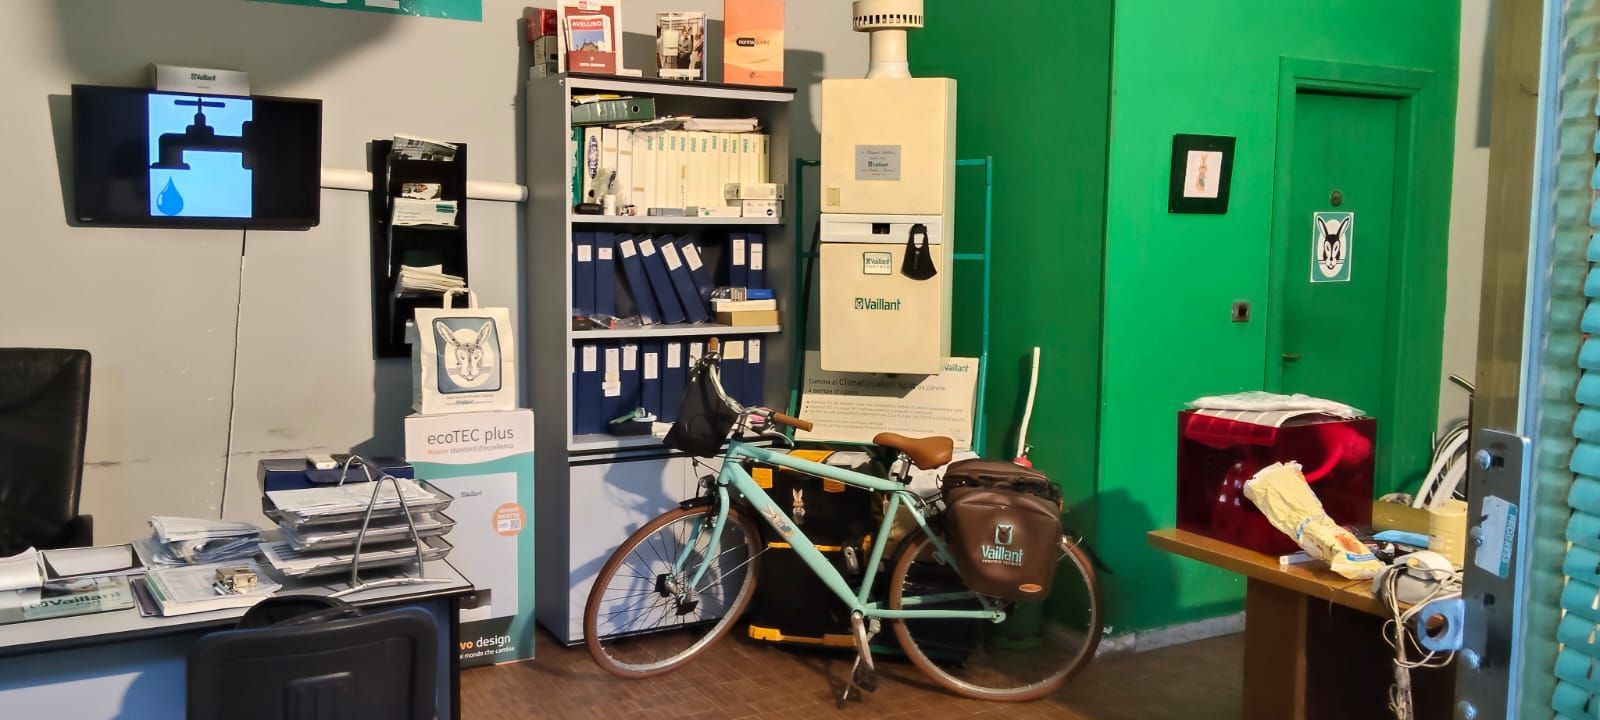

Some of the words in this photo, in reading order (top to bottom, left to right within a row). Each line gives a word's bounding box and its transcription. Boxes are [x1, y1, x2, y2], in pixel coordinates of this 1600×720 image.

[864, 298, 901, 311] Vaillant
[944, 364, 969, 373] Vaillant
[427, 428, 480, 445] ecoTEC
[484, 426, 514, 444] plus
[450, 445, 478, 454] standard
[982, 545, 1023, 562] Vaillant
[47, 592, 121, 606] Vaillant
[460, 641, 474, 650] vo
[476, 634, 511, 647] design
[464, 650, 483, 659] mondo
